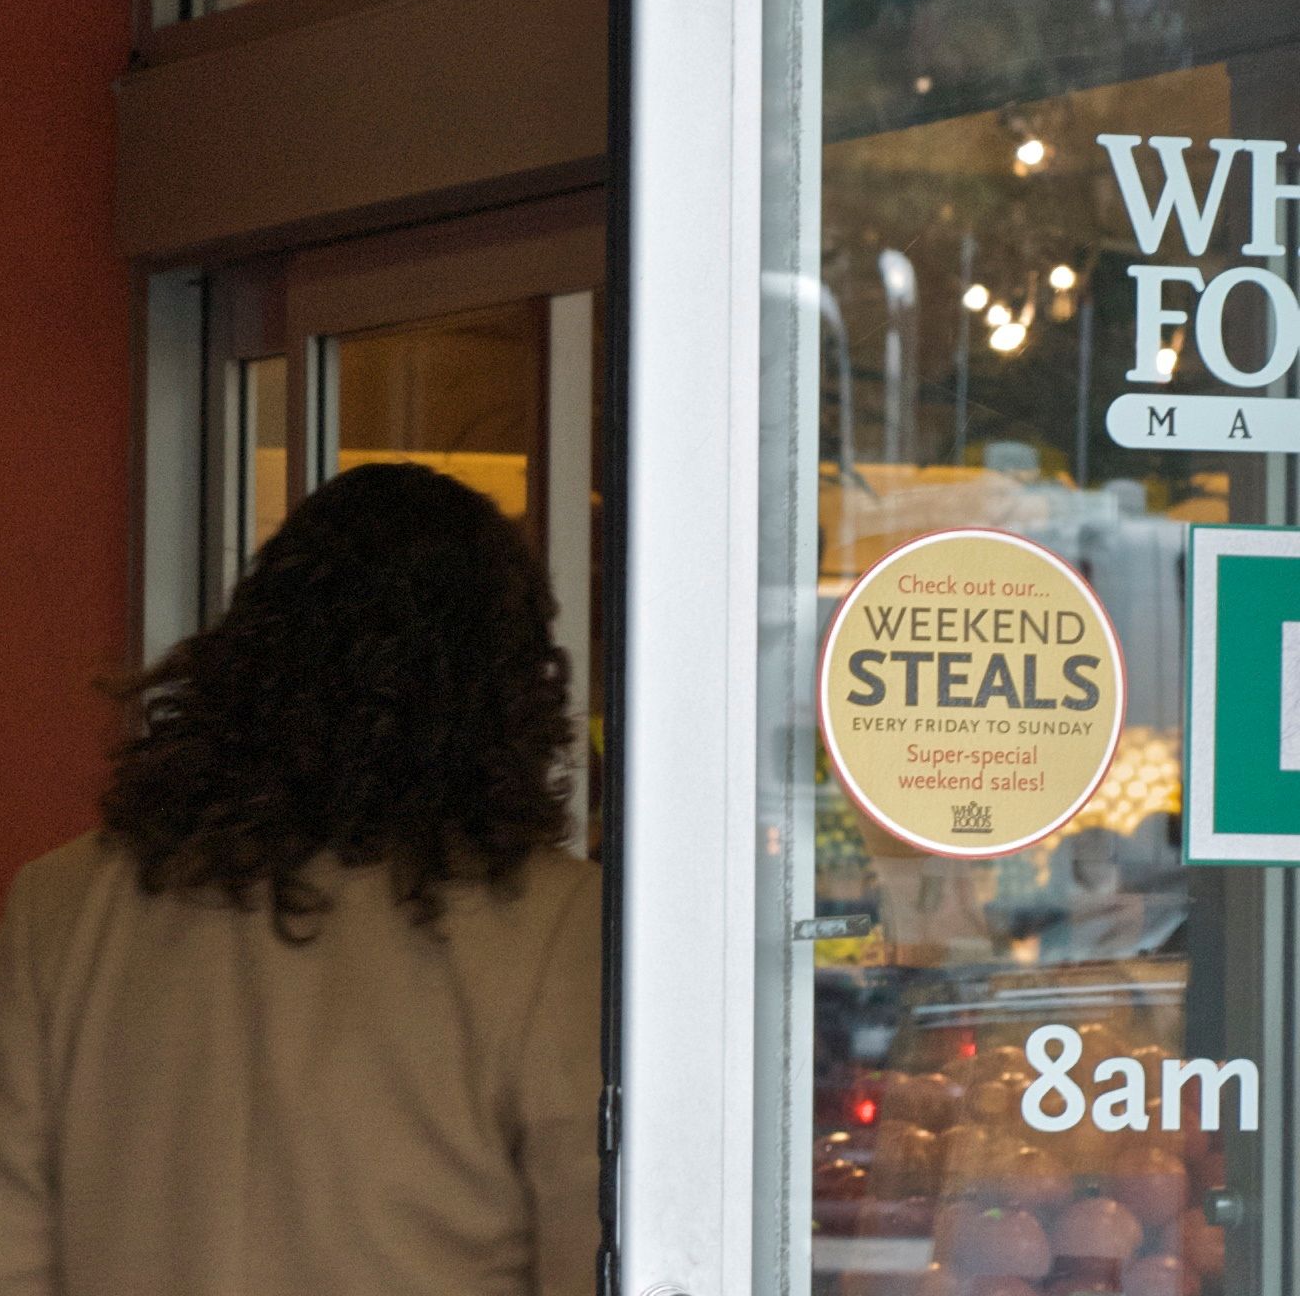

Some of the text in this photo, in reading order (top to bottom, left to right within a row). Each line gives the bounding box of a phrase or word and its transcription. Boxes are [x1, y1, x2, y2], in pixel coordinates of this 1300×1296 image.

[898, 573, 1050, 598] Check out our...
[863, 605, 1085, 646] WEEKEND
[846, 648, 1101, 712] STEALS
[852, 716, 1094, 737] EVERY FRIDAY TO SUNDAY
[906, 743, 1038, 771] Super-special
[898, 768, 1046, 792] weekend sales!
[951, 804, 992, 818] WHOLE
[1021, 1024, 1259, 1133] 8am
